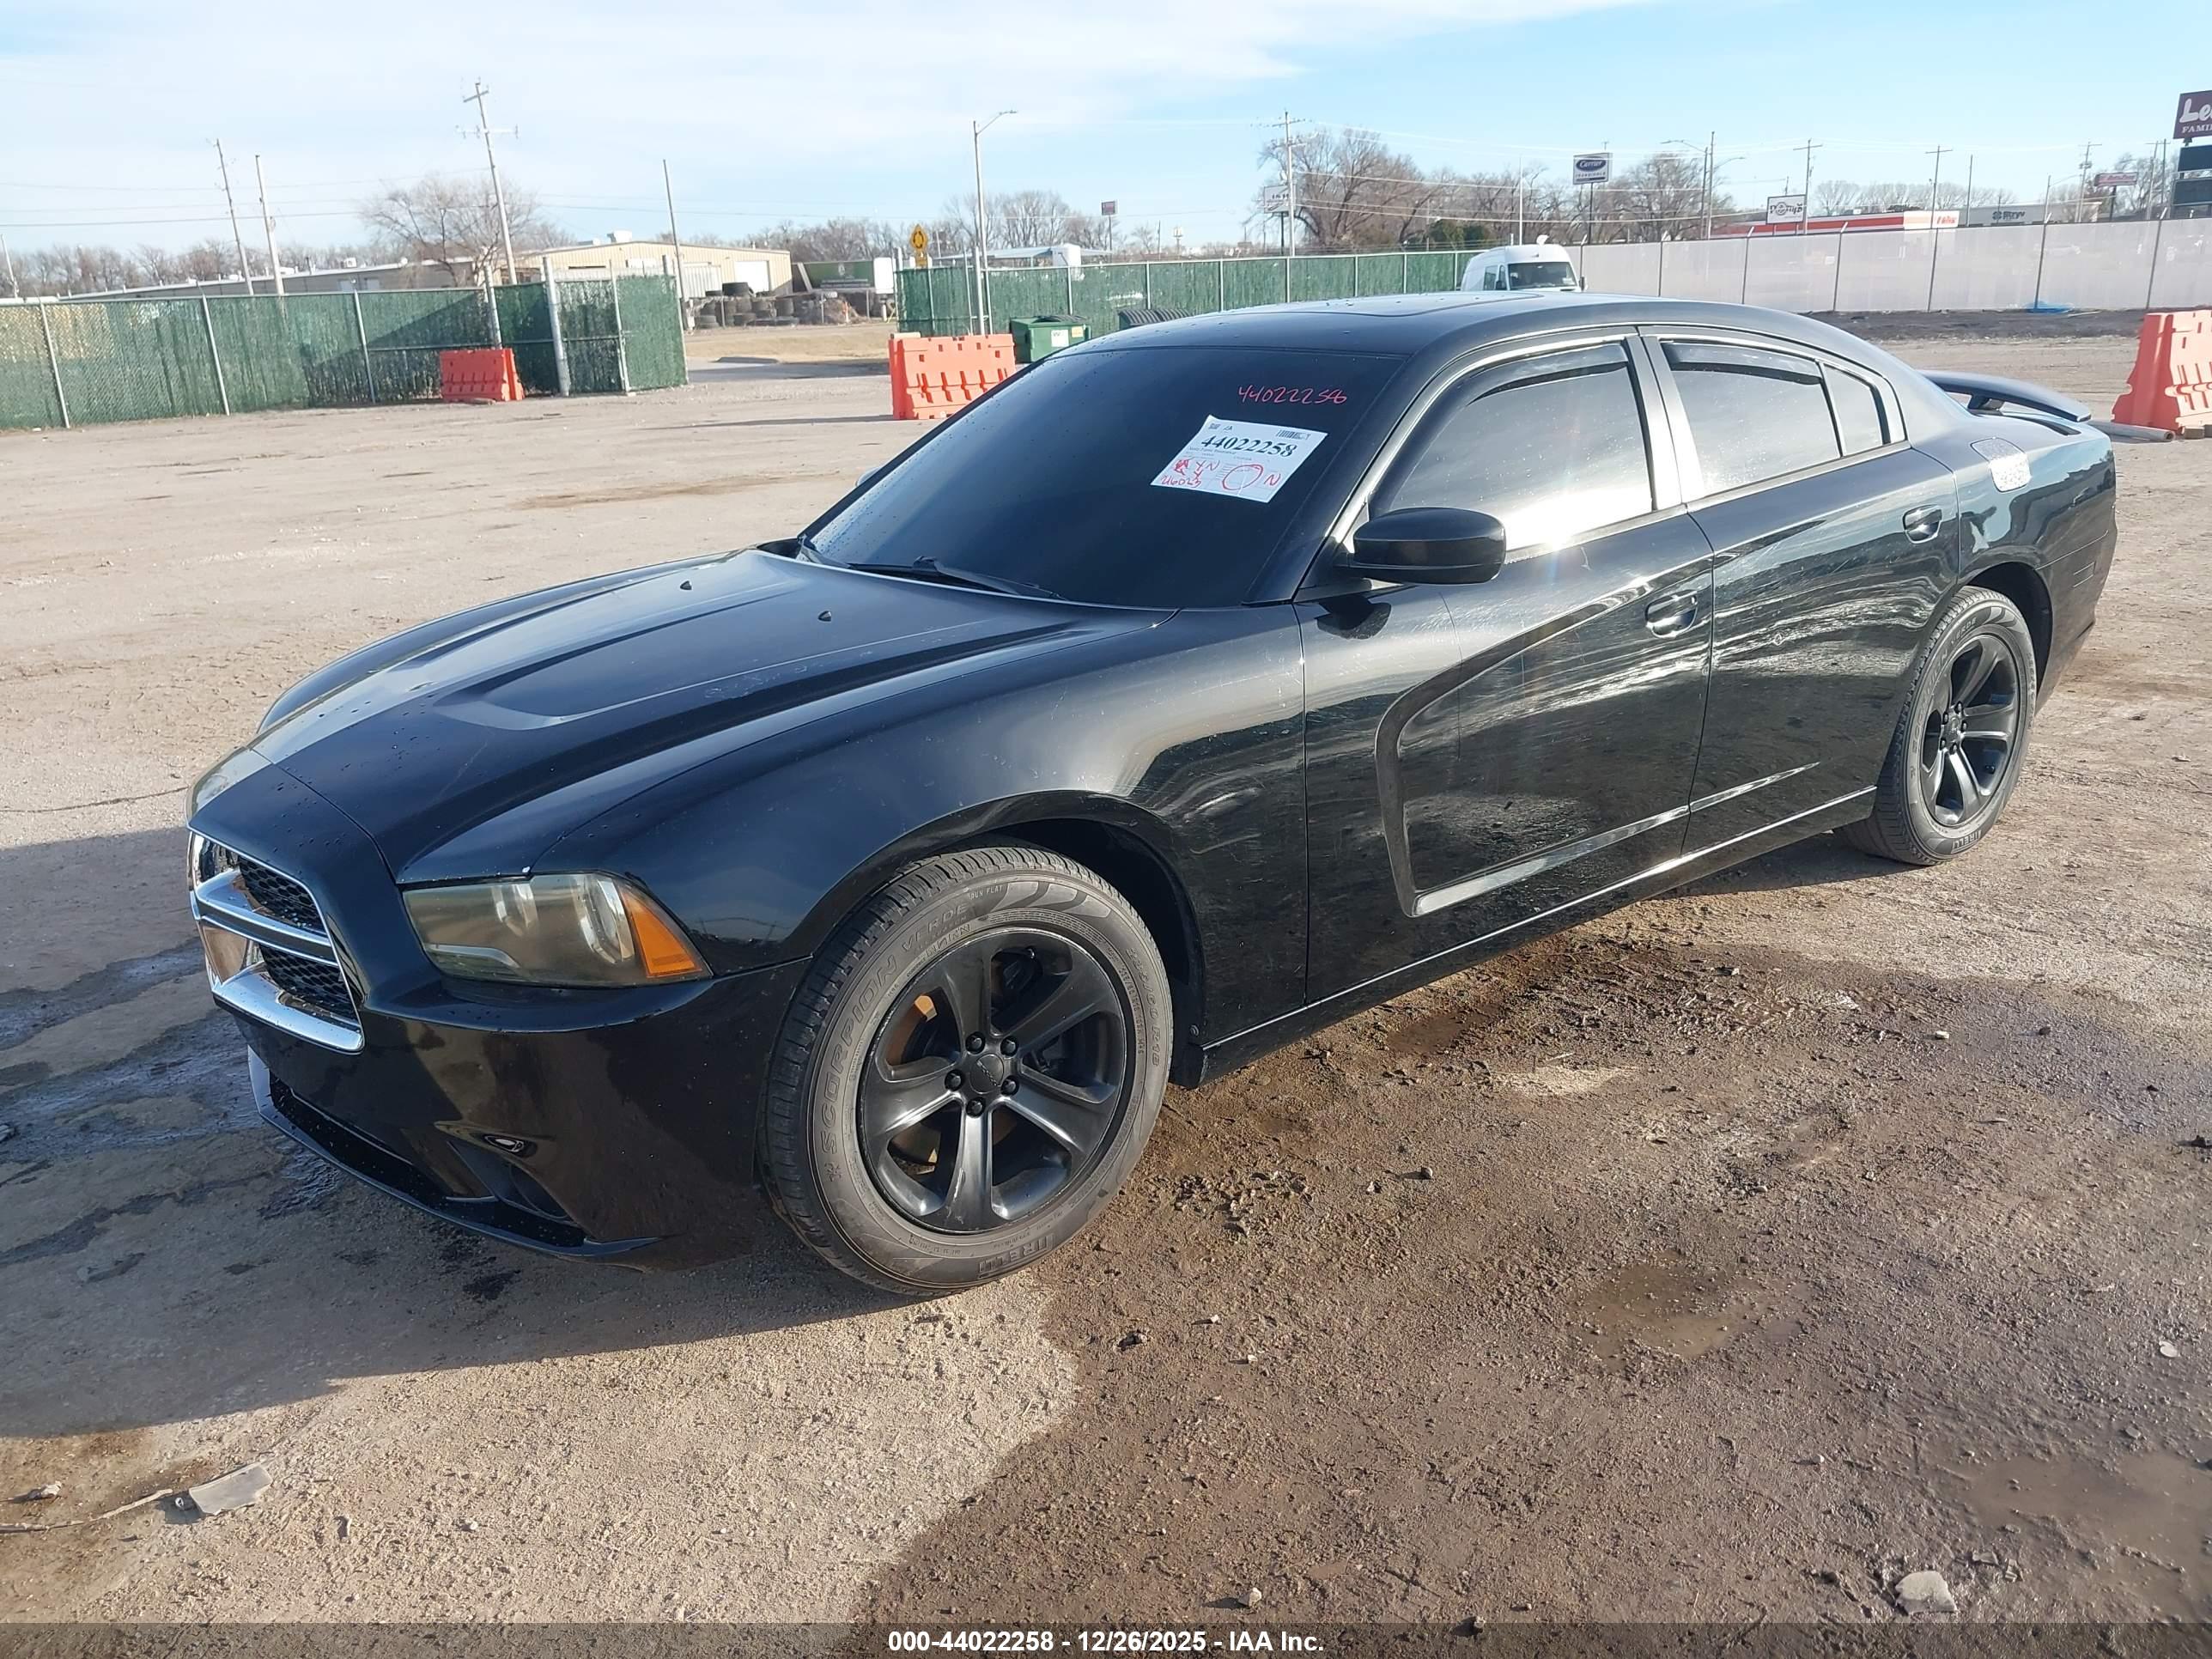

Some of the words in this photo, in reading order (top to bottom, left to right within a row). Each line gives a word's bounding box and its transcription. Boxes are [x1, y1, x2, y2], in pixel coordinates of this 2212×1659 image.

[2179, 98, 2212, 123] Le
[1201, 435, 1297, 457] 44022258
[822, 954, 897, 1155] SCORPION
